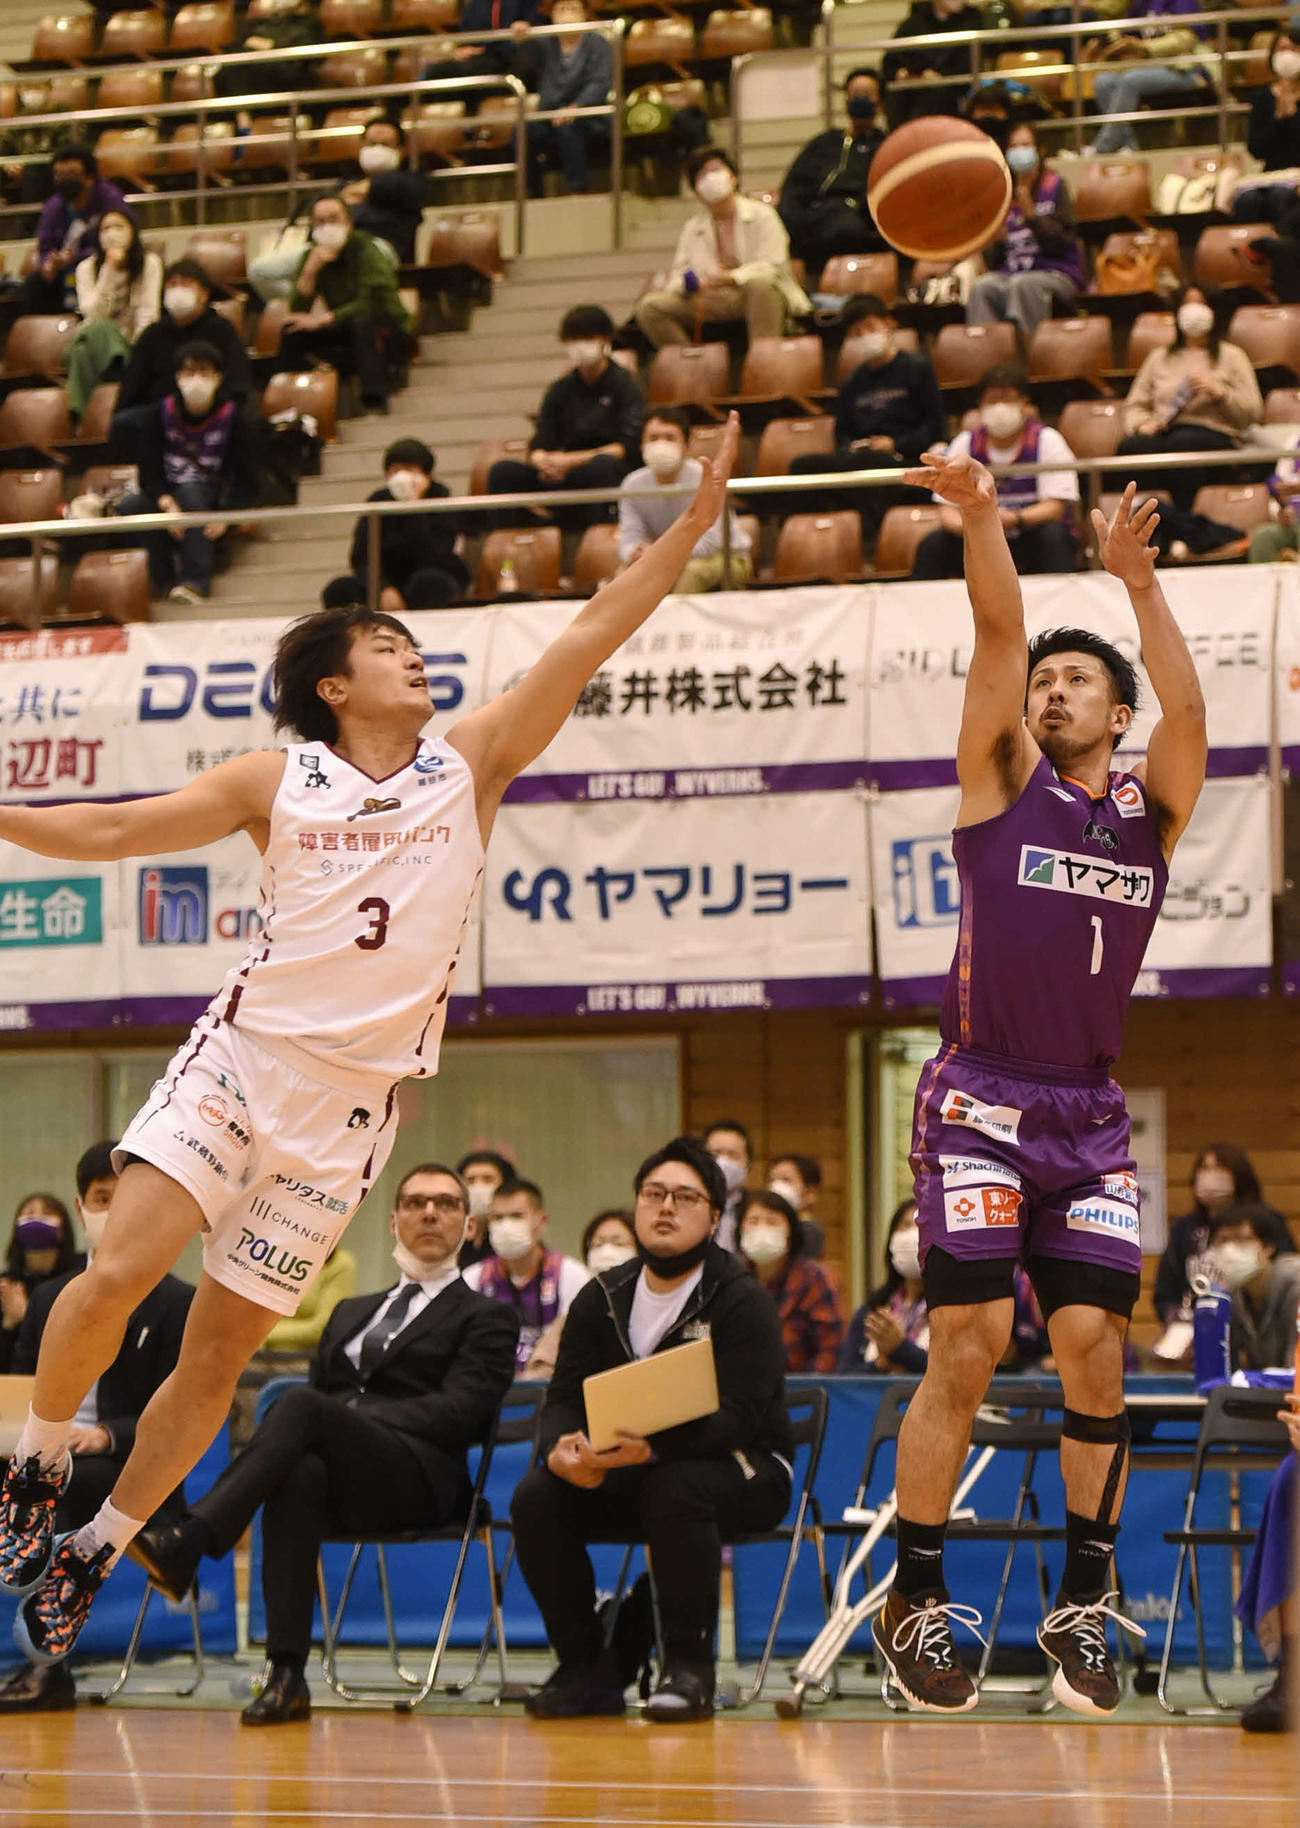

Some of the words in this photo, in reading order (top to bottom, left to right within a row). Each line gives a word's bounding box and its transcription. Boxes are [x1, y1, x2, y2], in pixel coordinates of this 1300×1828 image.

[0, 685, 80, 723] 共に
[585, 863, 848, 920] ヤマリョー
[354, 897, 391, 951] 3
[1090, 915, 1104, 975] 1
[264, 1173, 349, 1215] ャリタス就活
[235, 1227, 313, 1281] POLUS
[271, 1211, 329, 1245] CHANGE
